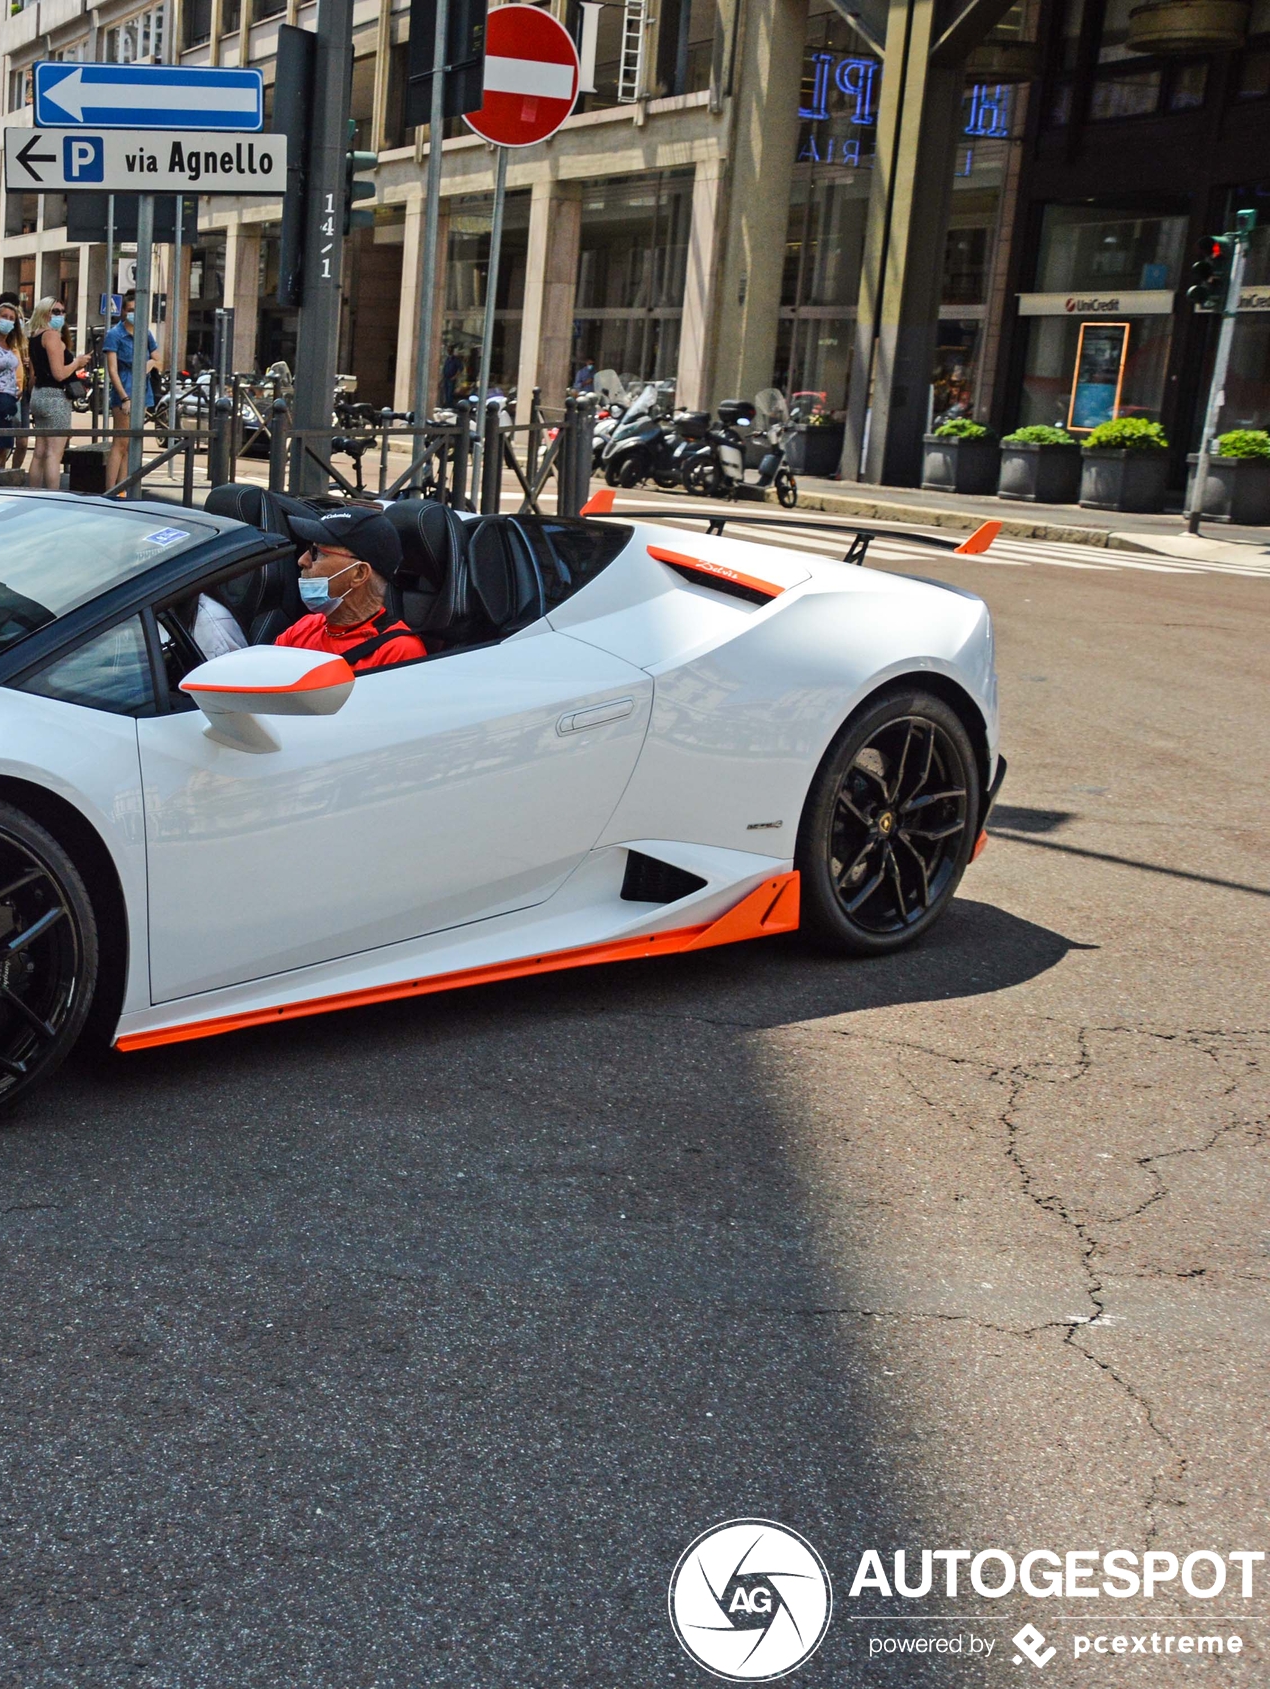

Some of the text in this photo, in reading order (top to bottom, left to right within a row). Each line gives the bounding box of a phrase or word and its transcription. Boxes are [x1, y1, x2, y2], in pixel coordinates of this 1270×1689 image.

[71, 140, 273, 181] P via Agnello
[1077, 298, 1120, 312] UniCredit
[326, 512, 352, 520] Columbia
